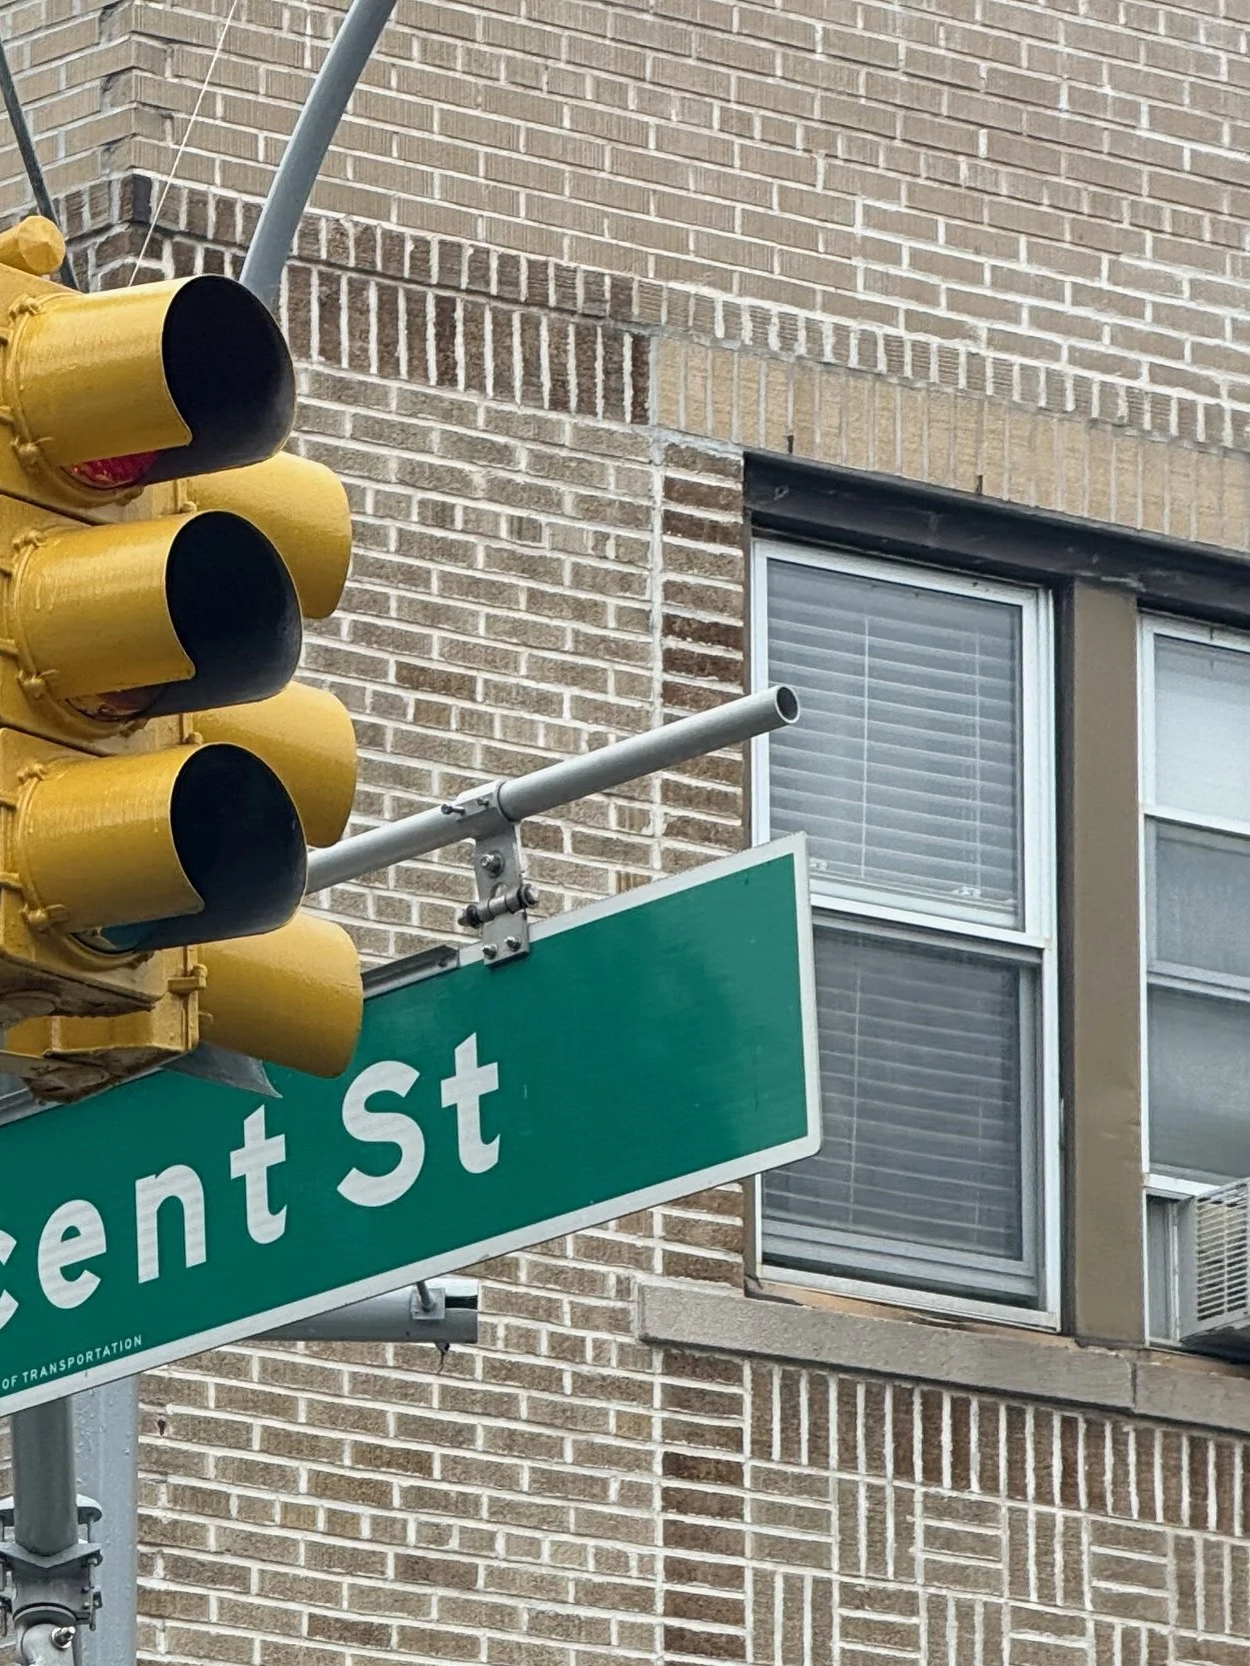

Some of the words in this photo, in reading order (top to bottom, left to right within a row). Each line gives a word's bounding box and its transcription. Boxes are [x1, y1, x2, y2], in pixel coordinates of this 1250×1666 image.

[337, 1032, 501, 1207] St
[2, 1375, 18, 1390] OF
[21, 1335, 142, 1384] TRANSPORTATION
